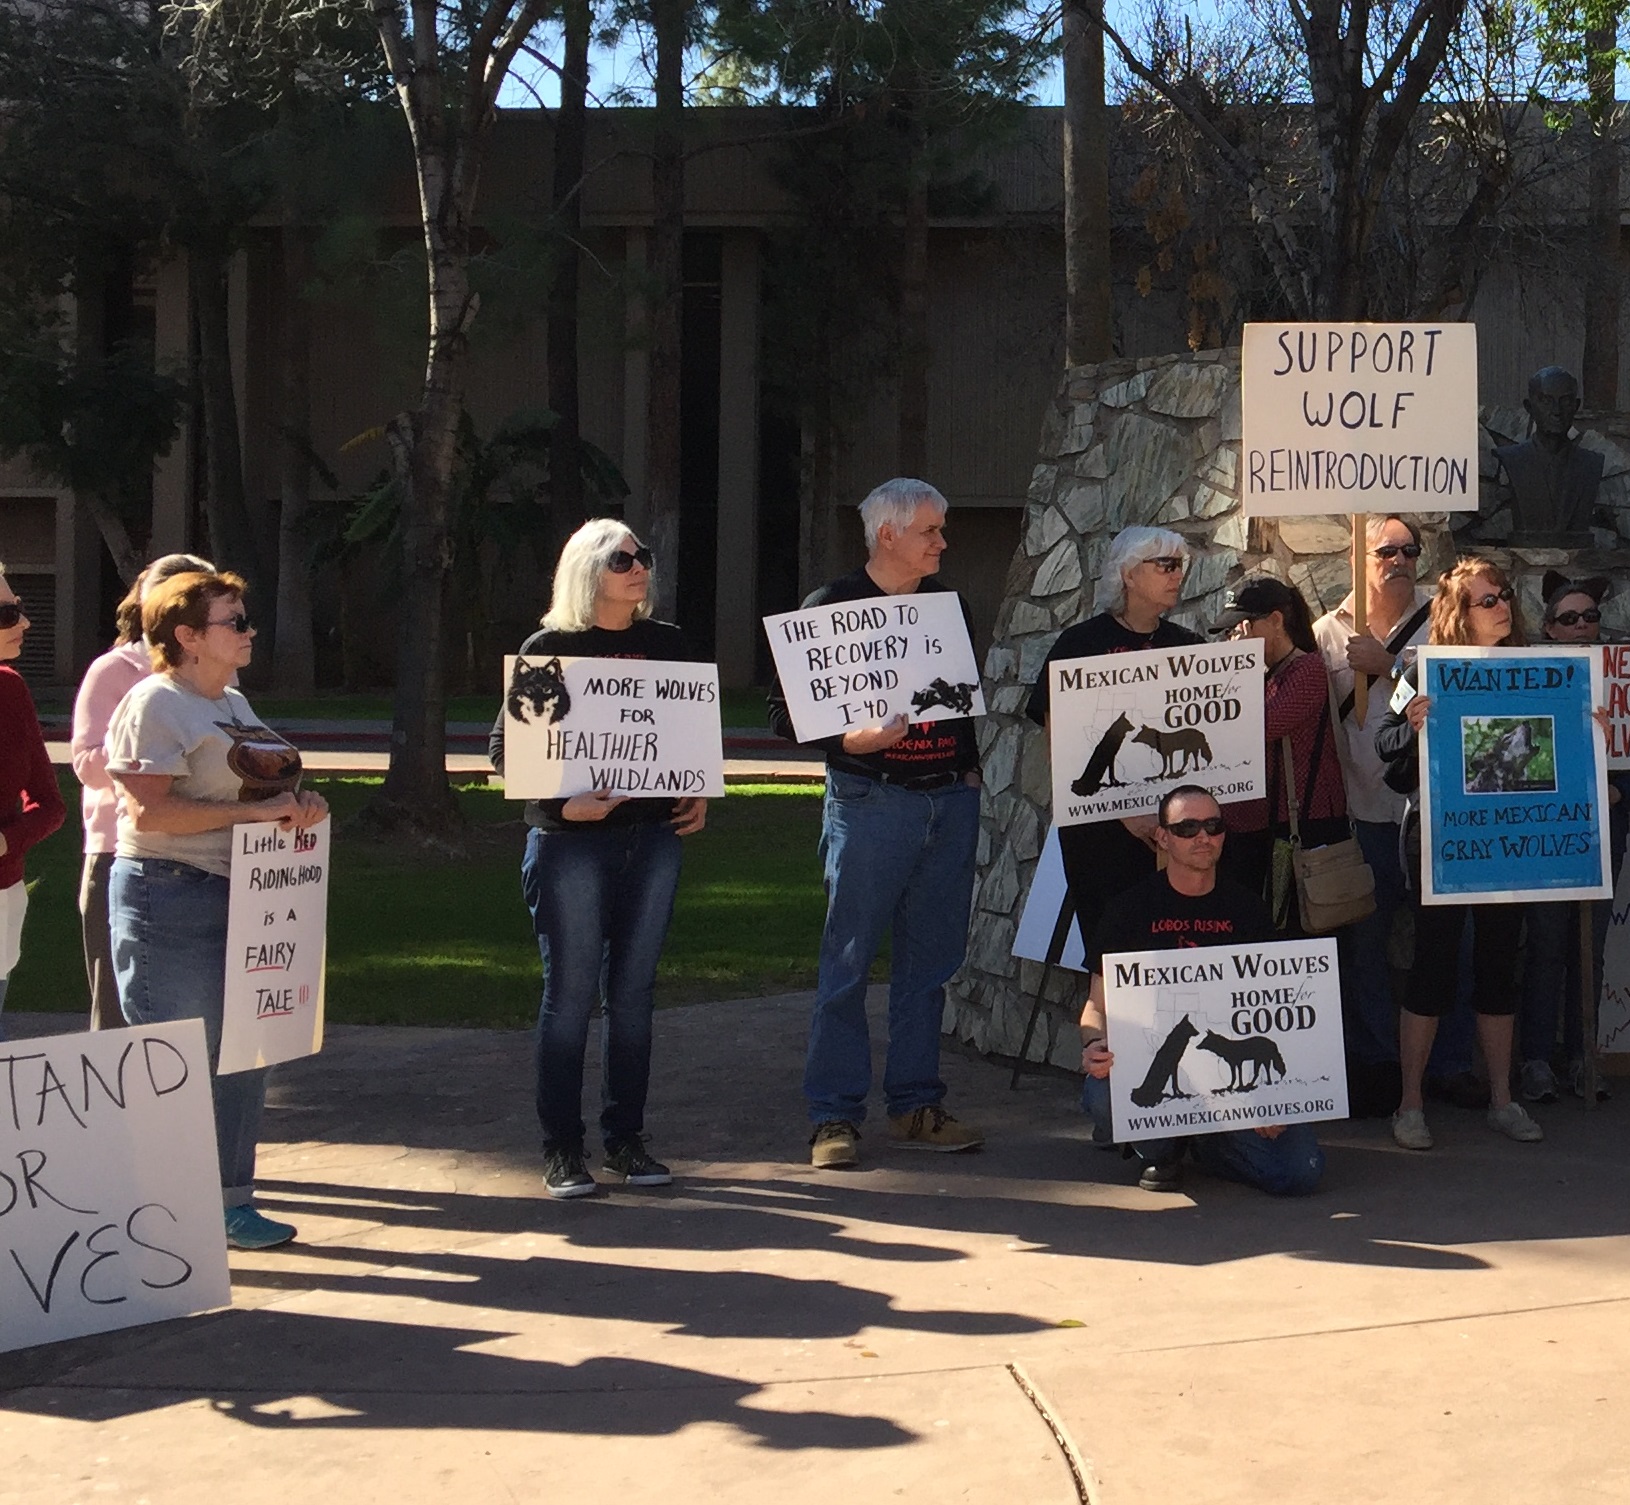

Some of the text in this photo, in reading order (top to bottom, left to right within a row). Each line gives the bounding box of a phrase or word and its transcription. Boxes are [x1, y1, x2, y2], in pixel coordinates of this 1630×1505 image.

[1274, 330, 1442, 376] SUPPORT
[1303, 391, 1414, 429] WOLF
[1250, 449, 1467, 494] REINTRODUCTION
[780, 605, 919, 643] THE ROAD TO
[806, 635, 942, 671] RECOVERY is
[810, 670, 899, 702] BEYOND
[1059, 653, 1256, 692] MEXICAN WOLVES
[1437, 662, 1574, 692] WANTED!
[583, 678, 715, 703] MORE WOLVES
[1165, 683, 1223, 704] HOME
[620, 709, 655, 725] FOR
[837, 699, 888, 726] I-40
[1164, 699, 1241, 728] GOOD
[547, 730, 658, 761] HEALTHIER
[589, 766, 705, 793] WILDLANDS
[1444, 803, 1593, 827] MORE MEXICAN
[243, 828, 286, 855] Little
[1441, 832, 1592, 861] GRAY WOLVES
[264, 909, 296, 926] is A
[1152, 920, 1190, 933] LOBOS
[245, 942, 296, 971] FAIRY
[1115, 954, 1329, 988] MEXICAN WOLVES
[256, 989, 294, 1015] TALE
[1231, 988, 1295, 1008] HOME
[1231, 1005, 1316, 1035] GOOD
[1128, 1099, 1334, 1130] WWW.MEXICANWOLVES.ORG
